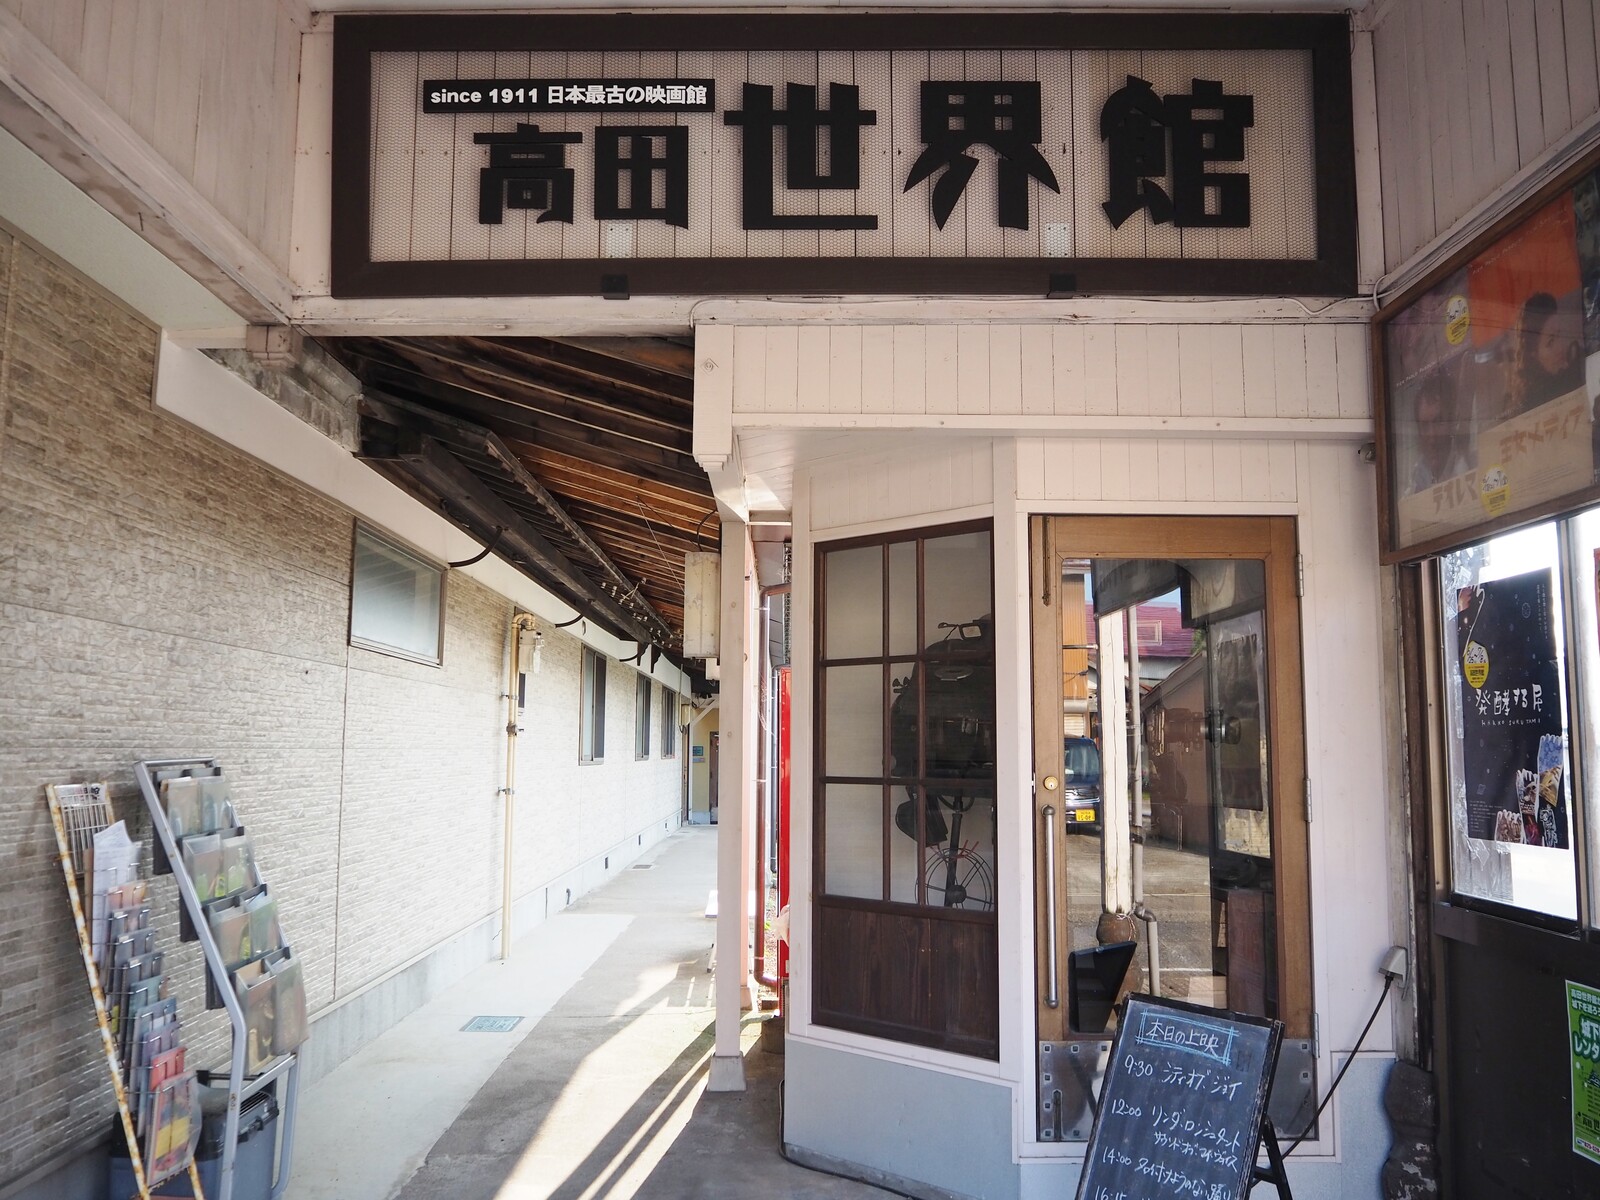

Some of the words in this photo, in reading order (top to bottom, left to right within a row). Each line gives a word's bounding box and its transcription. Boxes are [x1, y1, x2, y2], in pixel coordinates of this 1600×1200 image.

[431, 90, 482, 104] since
[489, 89, 539, 104] 1911
[547, 84, 708, 105] 日本最古の映画館
[473, 74, 1255, 232] 高田世界館
[1499, 405, 1585, 464] 王女メディア
[1475, 684, 1544, 716] 発酵する民
[1146, 1019, 1219, 1058] 本日の上映
[1124, 1055, 1153, 1076] 9:30
[1111, 1098, 1142, 1117] 12:00
[1102, 1146, 1132, 1166] 14:00
